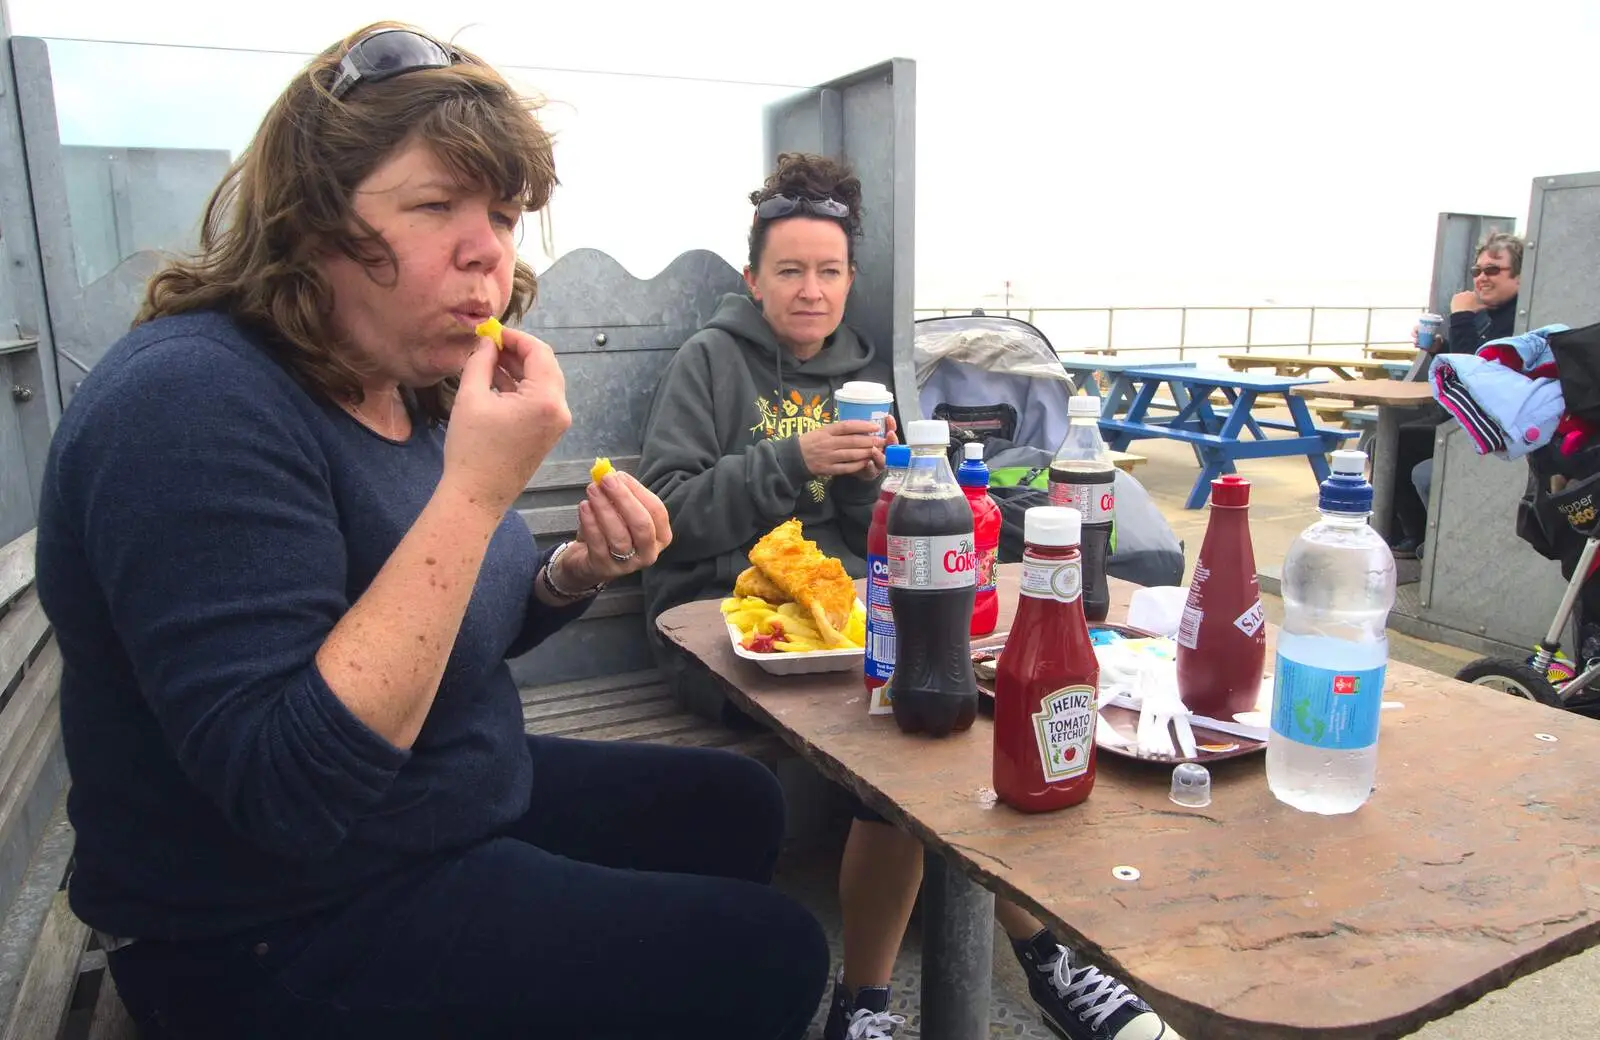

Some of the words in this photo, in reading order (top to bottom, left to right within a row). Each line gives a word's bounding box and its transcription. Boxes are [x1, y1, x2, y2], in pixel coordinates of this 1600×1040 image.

[873, 560, 889, 575] Oa
[1052, 695, 1089, 714] HEINZ
[1048, 713, 1090, 734] TOMATO
[1051, 726, 1088, 743] KETCHUP
